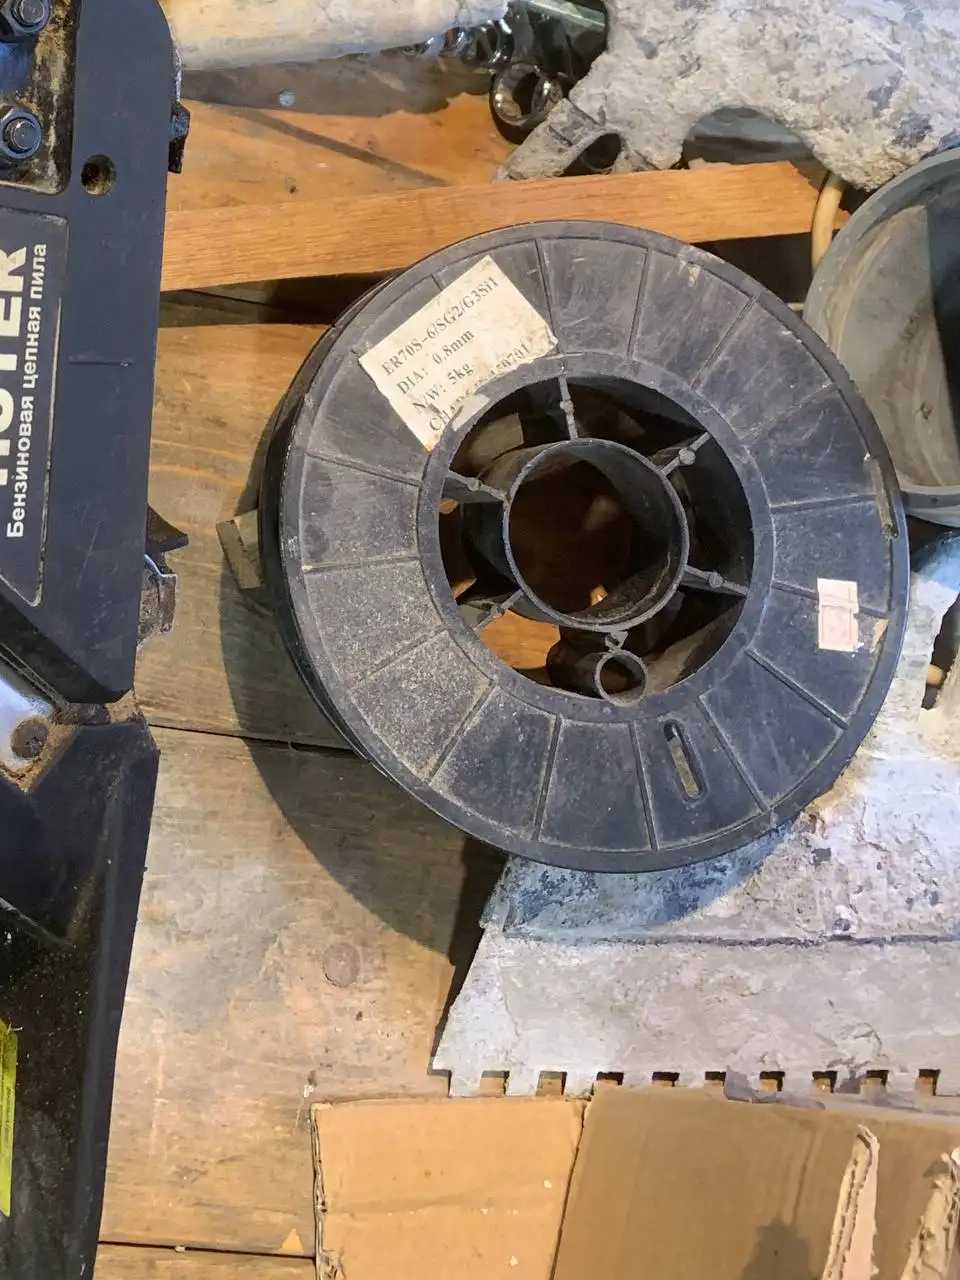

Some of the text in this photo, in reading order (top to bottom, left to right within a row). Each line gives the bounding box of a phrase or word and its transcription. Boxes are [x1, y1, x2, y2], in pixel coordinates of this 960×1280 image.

[381, 276, 499, 377] ER70S-6/SG2/G3Si1
[396, 330, 475, 394] DIA: 0.8mm
[6, 243, 47, 538] Бензиновая цепная пила
[447, 363, 473, 385] 5kg
